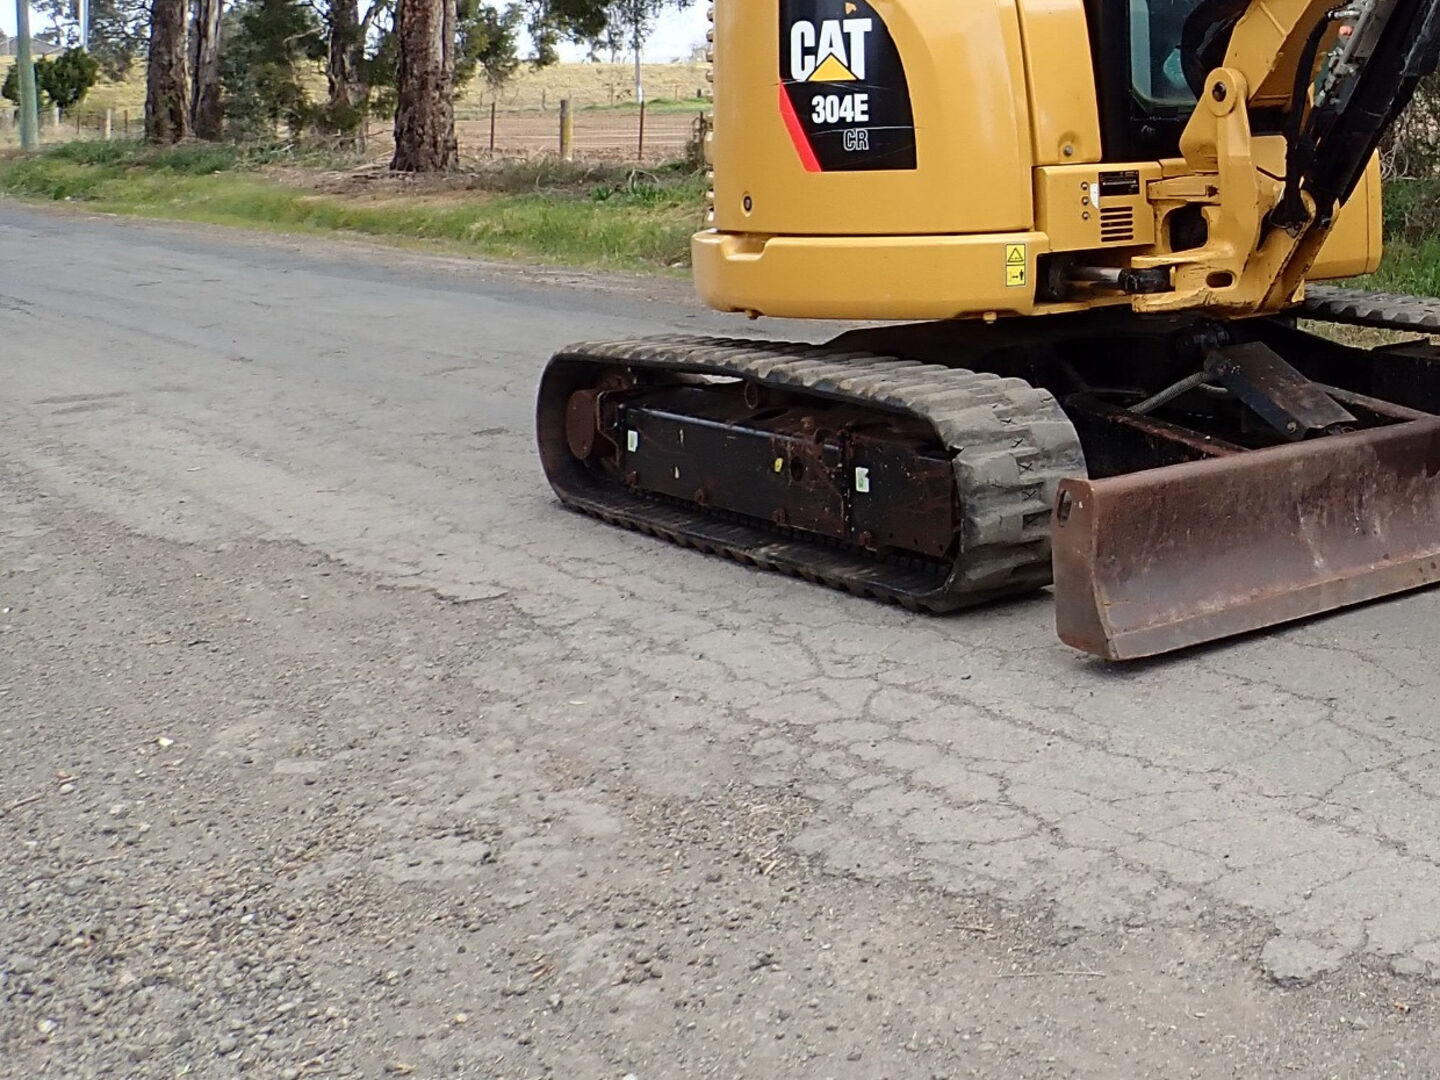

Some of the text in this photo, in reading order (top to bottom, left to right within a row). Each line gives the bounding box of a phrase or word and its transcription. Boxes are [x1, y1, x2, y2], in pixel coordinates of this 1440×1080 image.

[790, 18, 873, 82] CAT
[811, 93, 870, 124] 304E
[843, 128, 870, 152] CR
